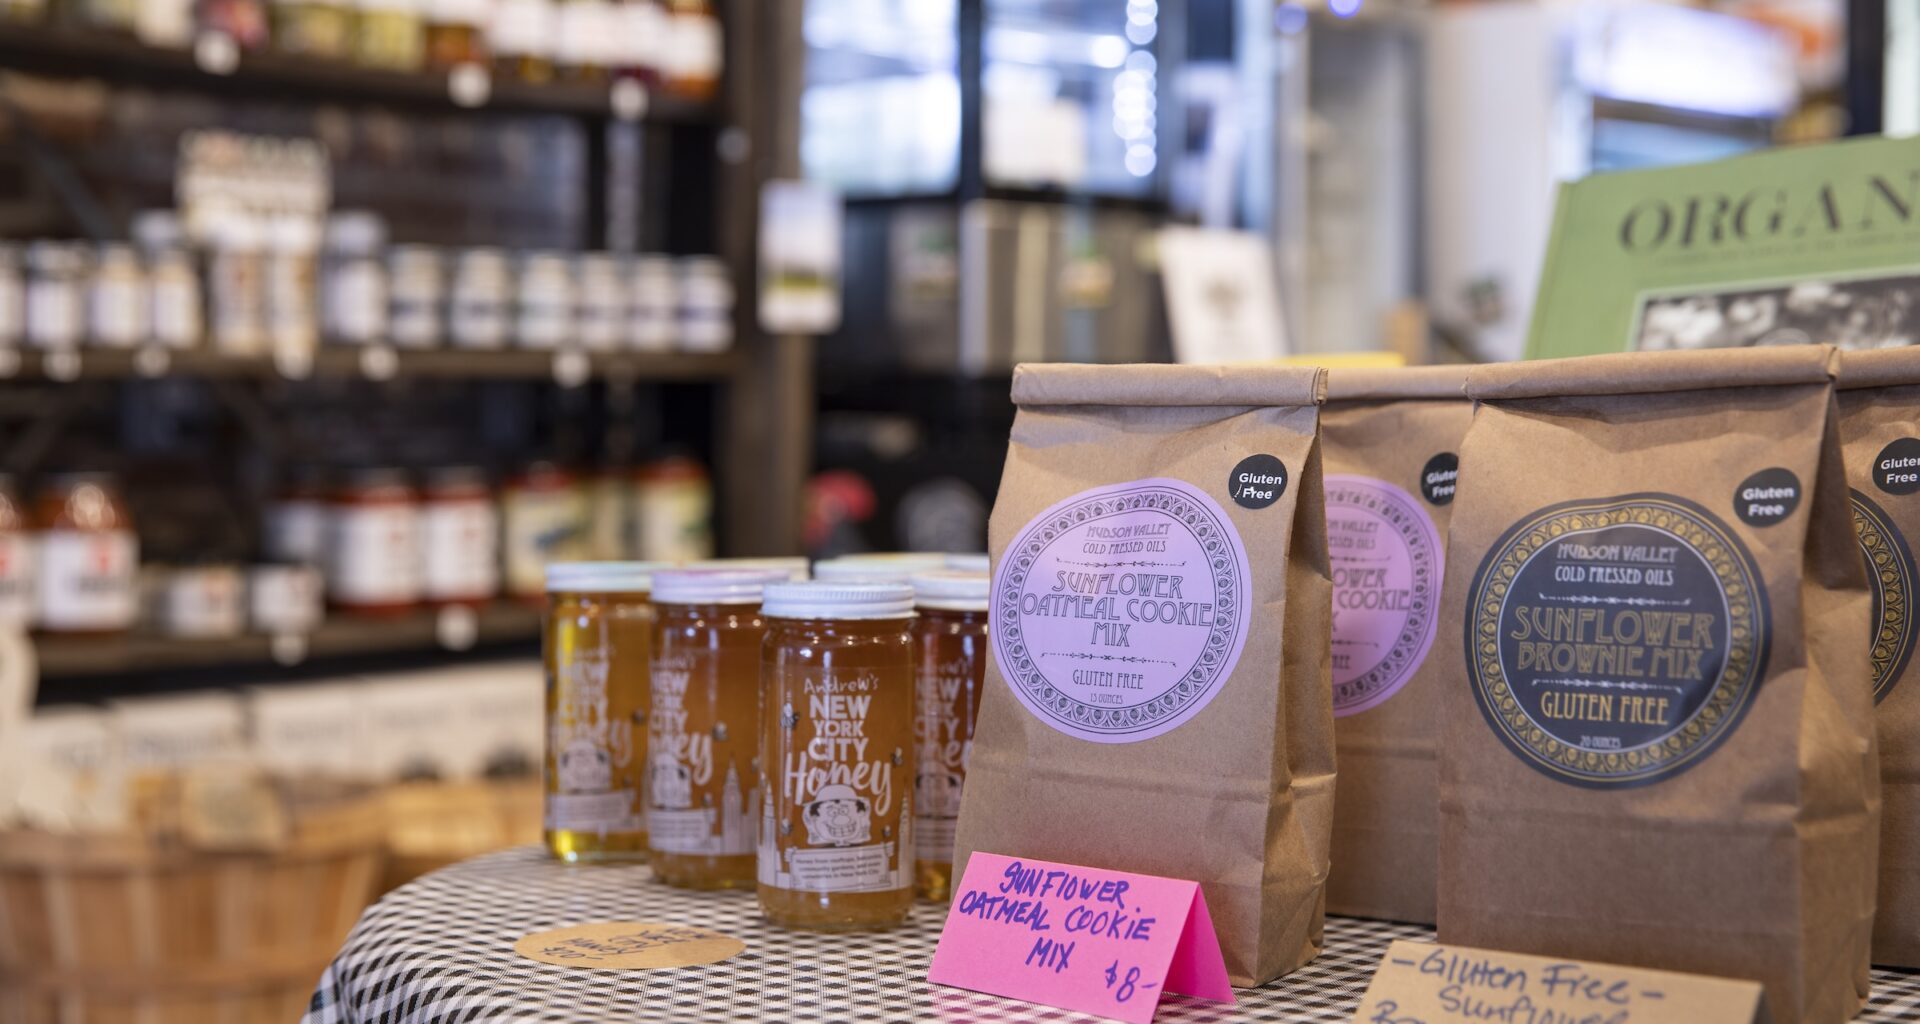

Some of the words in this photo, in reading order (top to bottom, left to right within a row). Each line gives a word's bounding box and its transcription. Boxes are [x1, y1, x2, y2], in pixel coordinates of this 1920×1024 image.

[1238, 472, 1282, 485] Gluten
[1886, 473, 1918, 484] Free
[1242, 486, 1273, 499] Free
[1742, 487, 1795, 500] Gluten
[1748, 503, 1785, 516] Free
[1082, 542, 1106, 555] COLD
[1108, 540, 1144, 555] PRESSED
[1146, 540, 1166, 553] OILS
[1052, 570, 1184, 600] SUNFLOWER
[1554, 565, 1586, 582] COLD
[1588, 566, 1643, 585] PRESSED
[1644, 568, 1675, 586] OILS
[1020, 592, 1120, 621] OATMEAL
[1126, 598, 1213, 627] COOKIE
[1336, 590, 1411, 612] COOKIE
[1090, 622, 1130, 648] MIX
[1510, 606, 1715, 649] SUNFLOWER
[1517, 643, 1645, 677] BROWNIE
[1649, 647, 1704, 681] MIX
[803, 672, 879, 694] Andrew's
[1072, 669, 1113, 688] GLUTEN
[1116, 672, 1144, 690] FREE
[809, 695, 872, 720] NEW
[1540, 691, 1613, 721] GLUTEN
[1618, 696, 1669, 726] FREE
[813, 719, 865, 737] YORK
[807, 736, 870, 761] CITY
[784, 750, 892, 817] Honey
[999, 860, 1130, 909] SUNFLOWER
[958, 890, 1050, 932] OATMEAL
[1025, 936, 1075, 973] MIX
